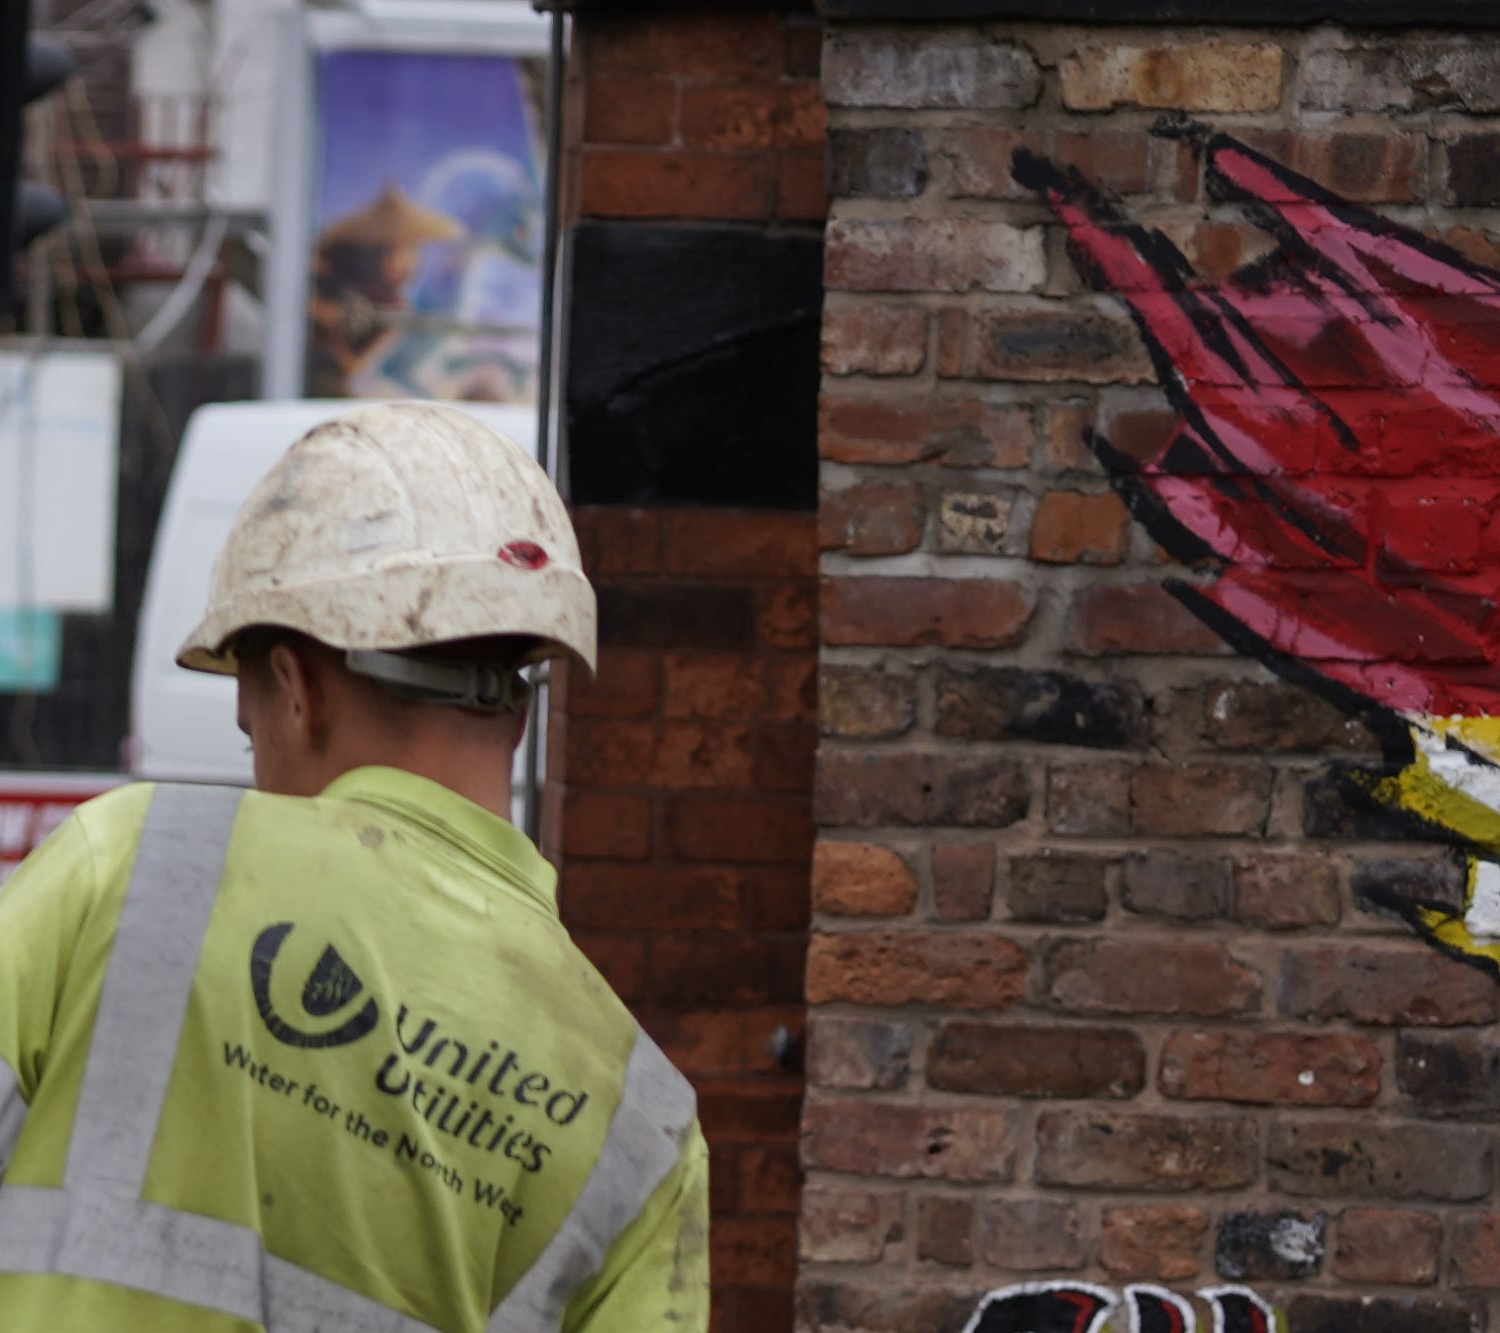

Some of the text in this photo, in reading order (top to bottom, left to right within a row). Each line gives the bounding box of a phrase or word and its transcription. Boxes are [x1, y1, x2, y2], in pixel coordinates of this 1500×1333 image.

[375, 1053, 552, 1173] Utilities
[396, 1004, 588, 1126] United
[303, 1084, 342, 1120] for
[345, 1112, 390, 1148] the
[395, 1132, 464, 1195] North
